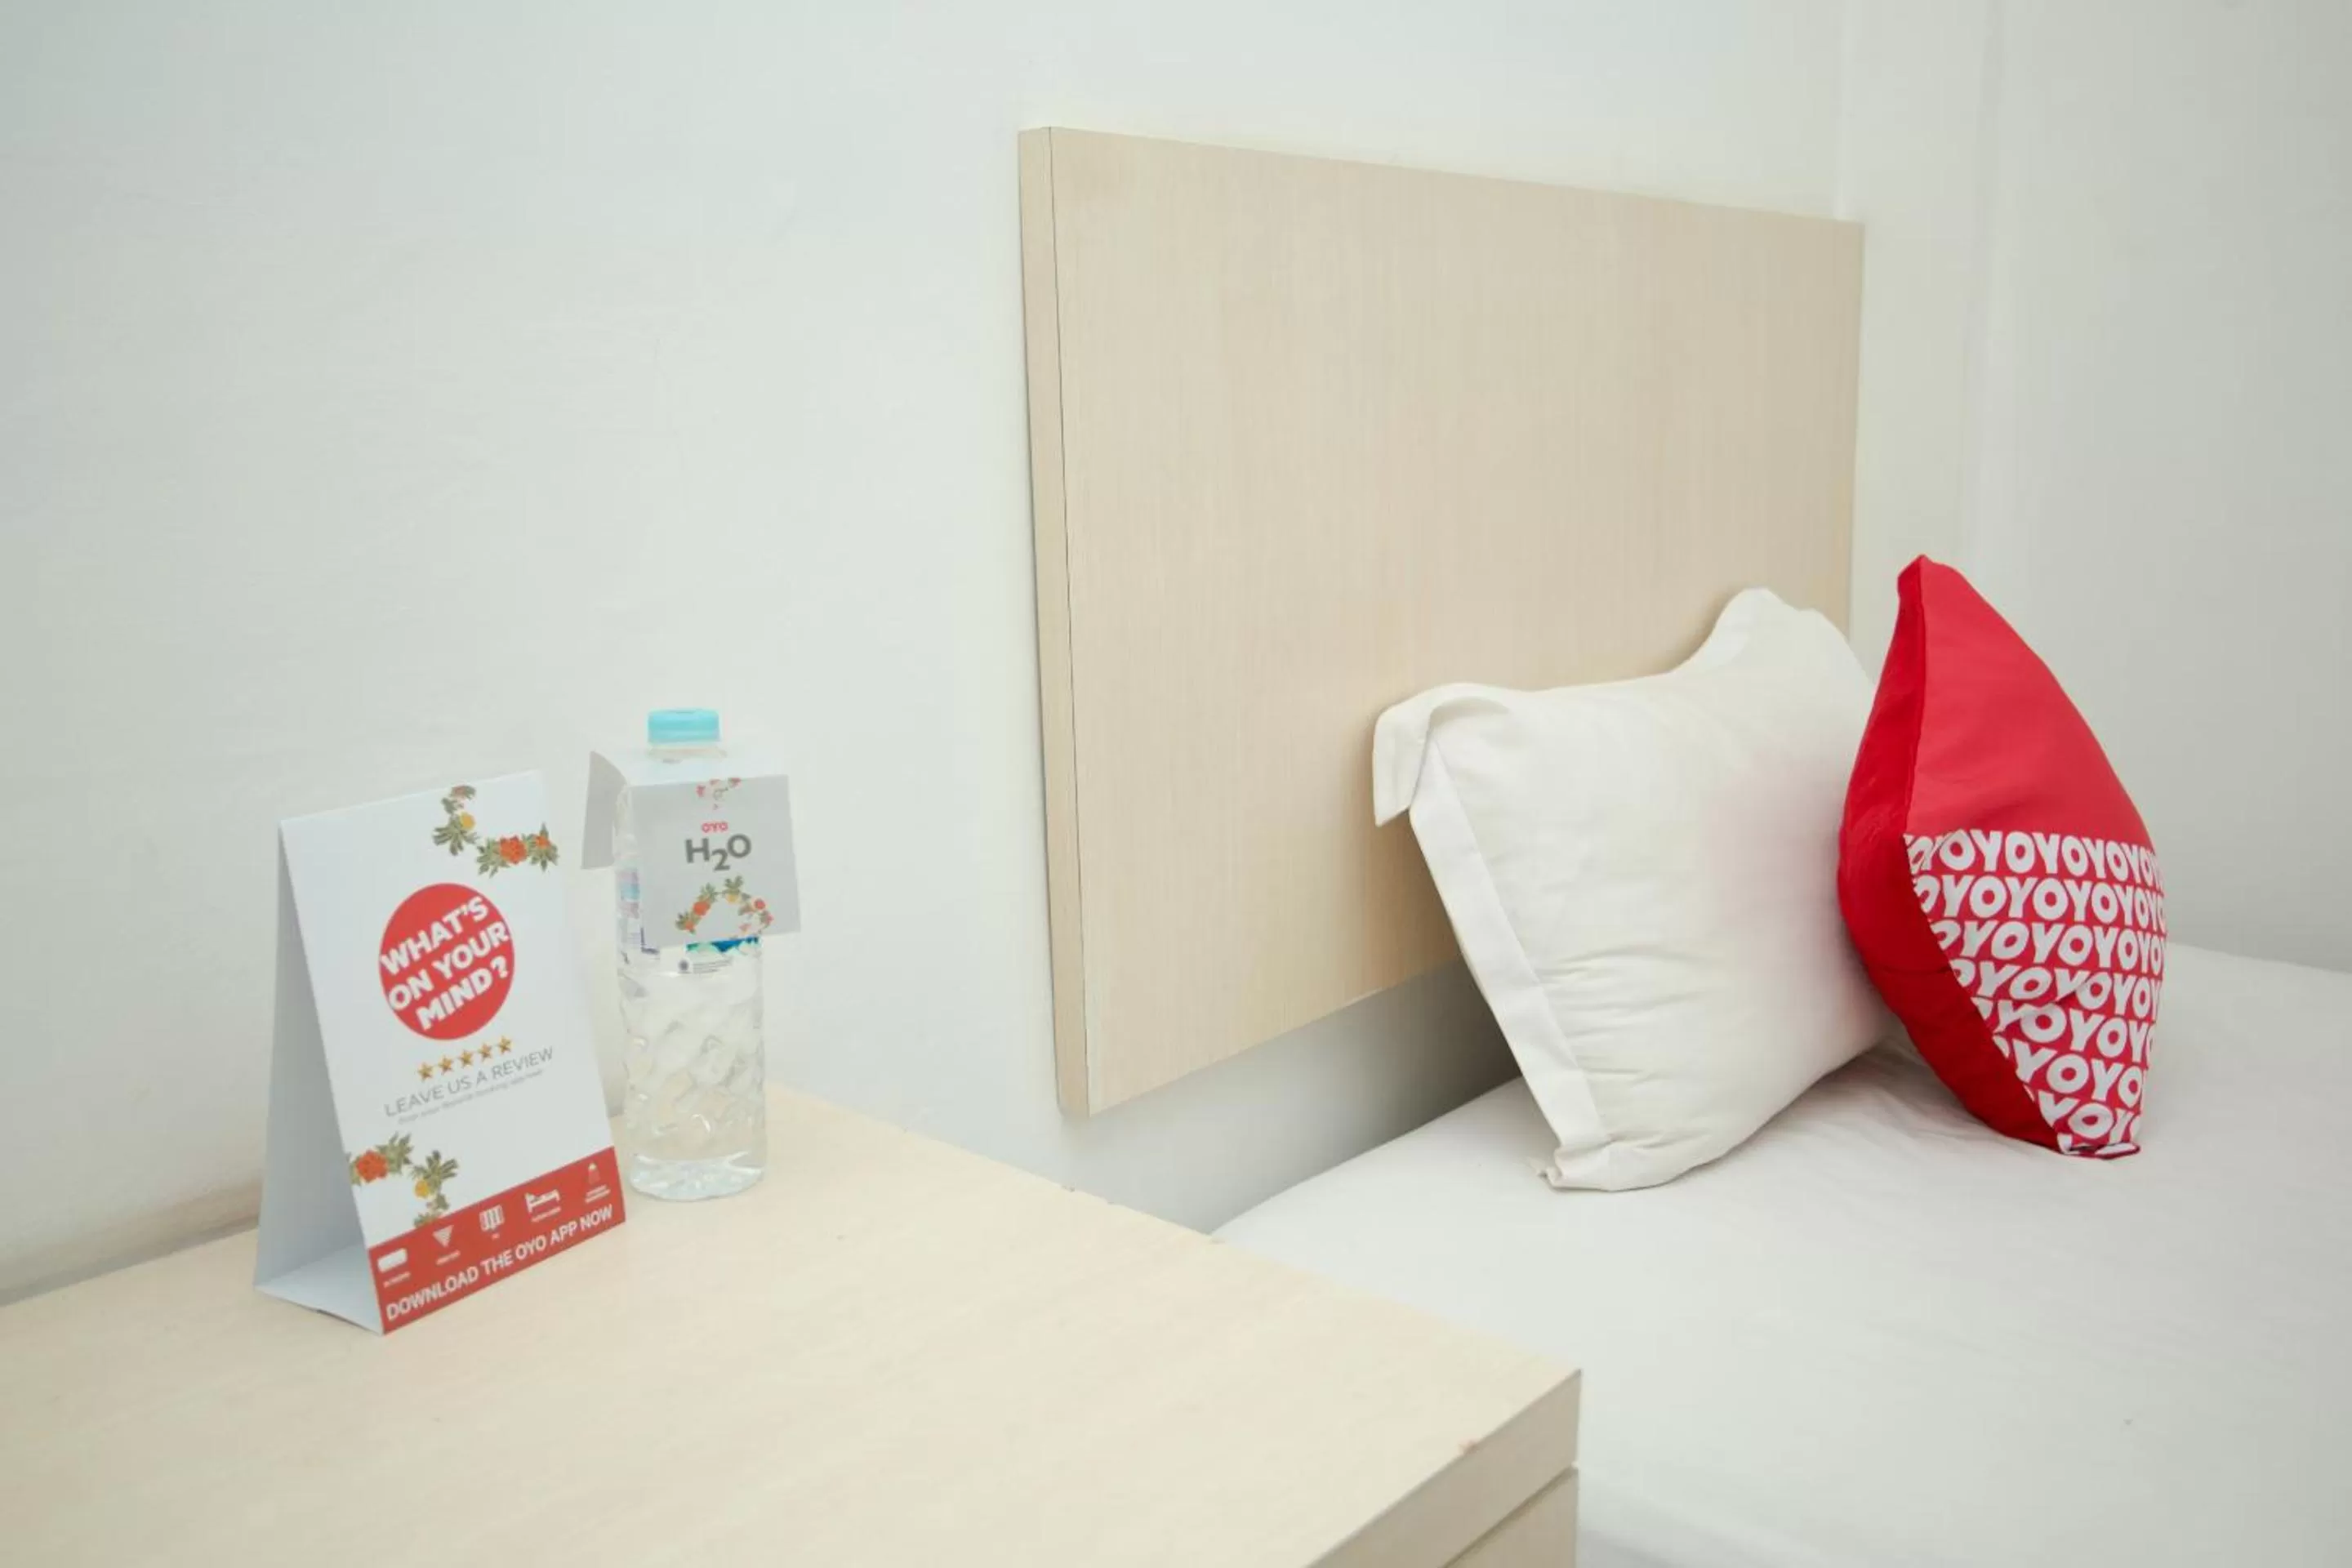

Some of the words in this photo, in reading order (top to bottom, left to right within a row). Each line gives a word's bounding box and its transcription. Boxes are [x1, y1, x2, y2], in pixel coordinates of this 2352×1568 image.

[684, 834, 752, 871] H2O
[702, 821, 728, 833] OYO
[380, 896, 488, 975] WHAT'S
[388, 969, 434, 1011] ON
[431, 920, 509, 980] YOUR
[384, 1084, 444, 1117] LEAVE
[448, 1076, 472, 1094] US
[476, 1070, 488, 1085] A
[492, 1046, 553, 1080] REVIEW
[386, 1266, 479, 1321] DOWNLOAD
[480, 1254, 514, 1275] THE
[515, 1235, 546, 1261] OYO
[550, 1220, 577, 1245] APP
[580, 1204, 612, 1231] NOW
